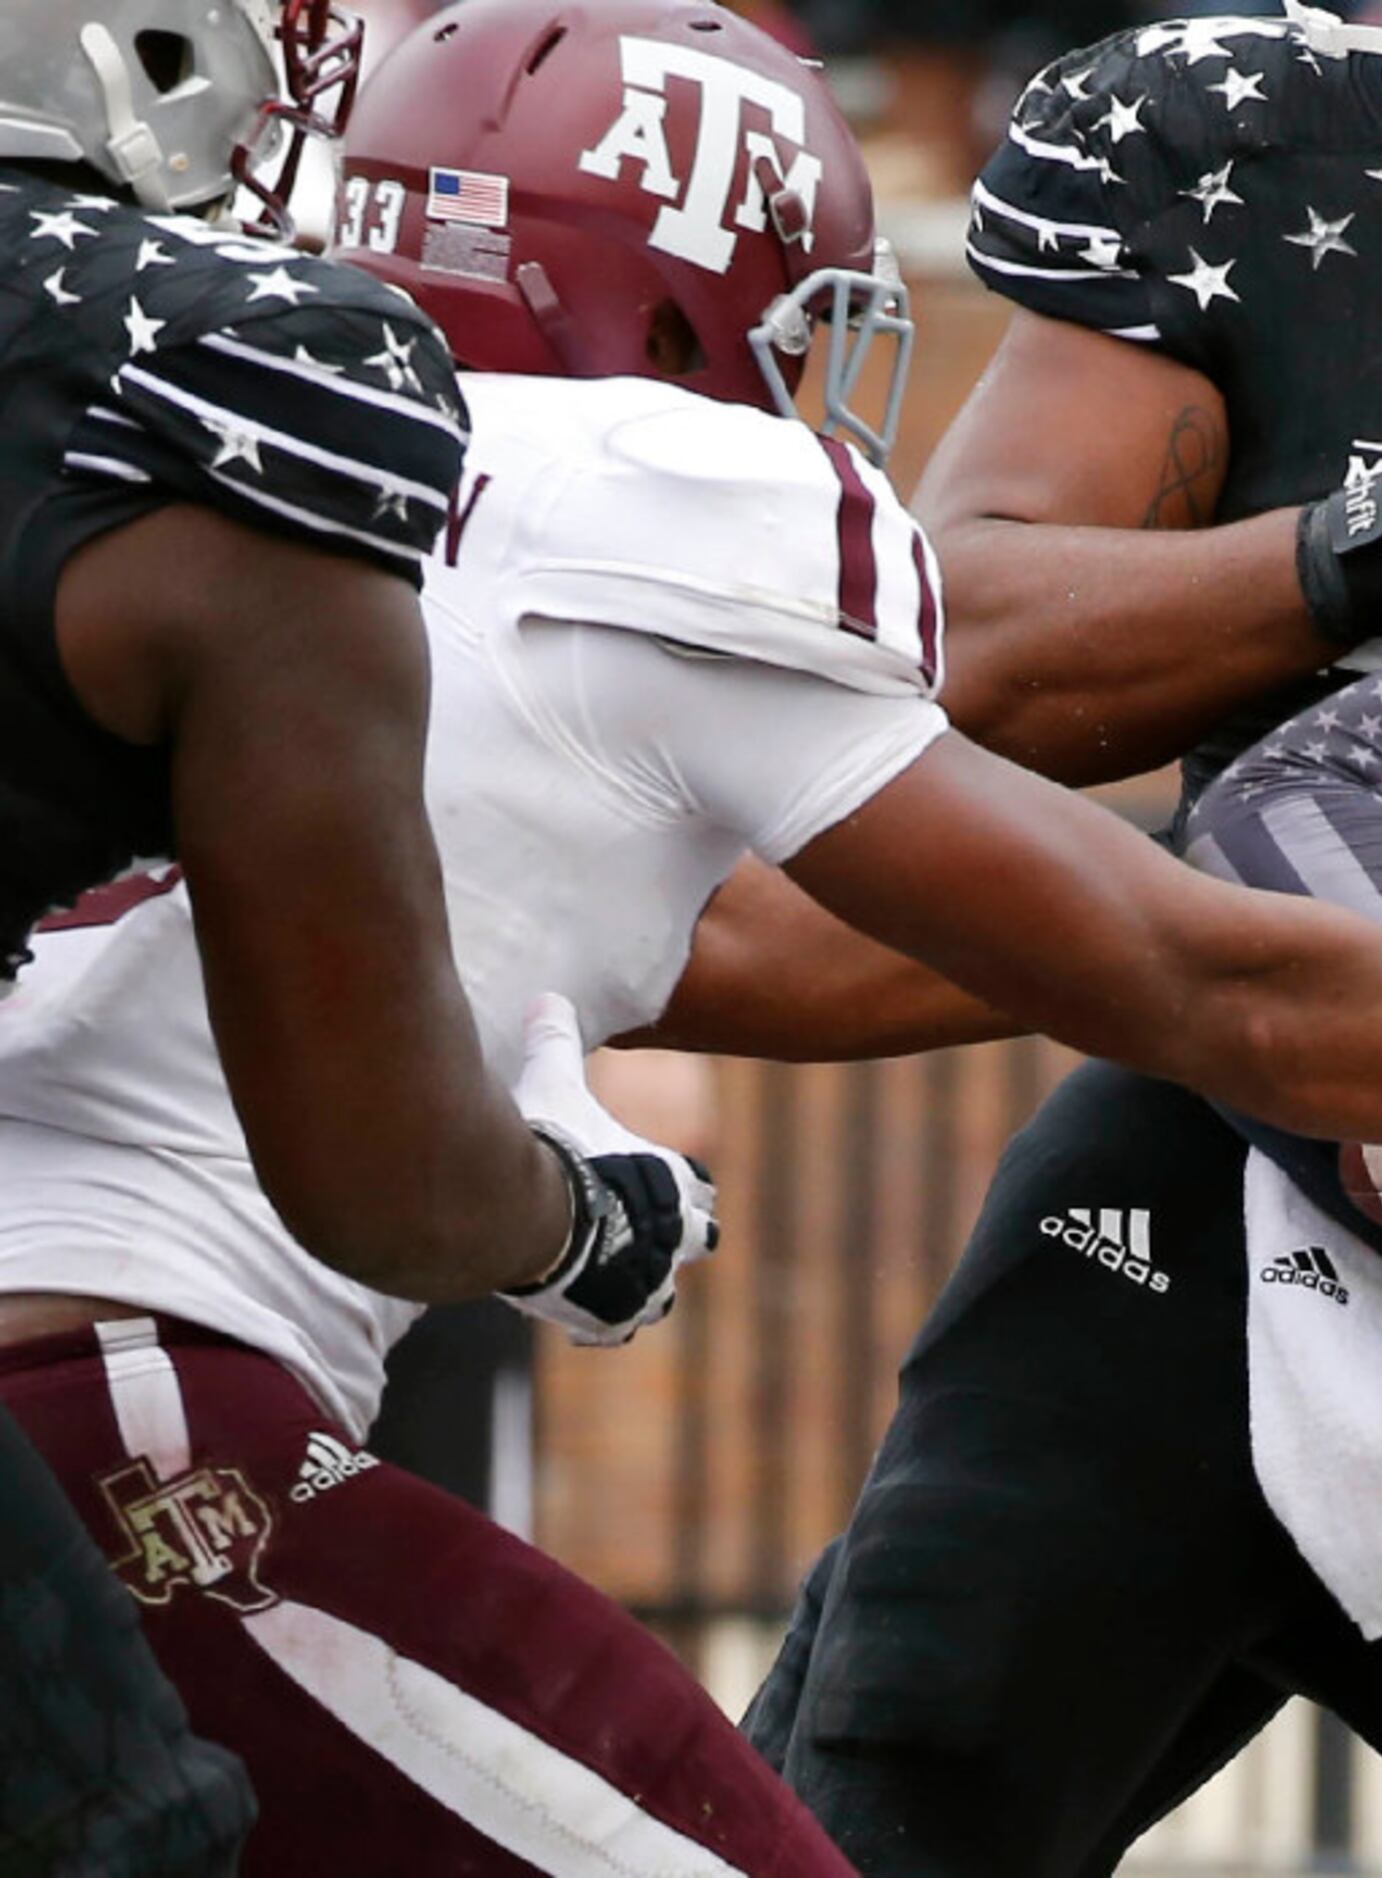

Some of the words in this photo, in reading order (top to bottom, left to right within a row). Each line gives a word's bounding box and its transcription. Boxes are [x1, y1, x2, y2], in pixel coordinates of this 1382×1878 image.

[341, 176, 406, 256] 33
[1039, 1215, 1170, 1293] adidas
[1260, 1266, 1349, 1305] adidas
[290, 1450, 381, 1502] adida
